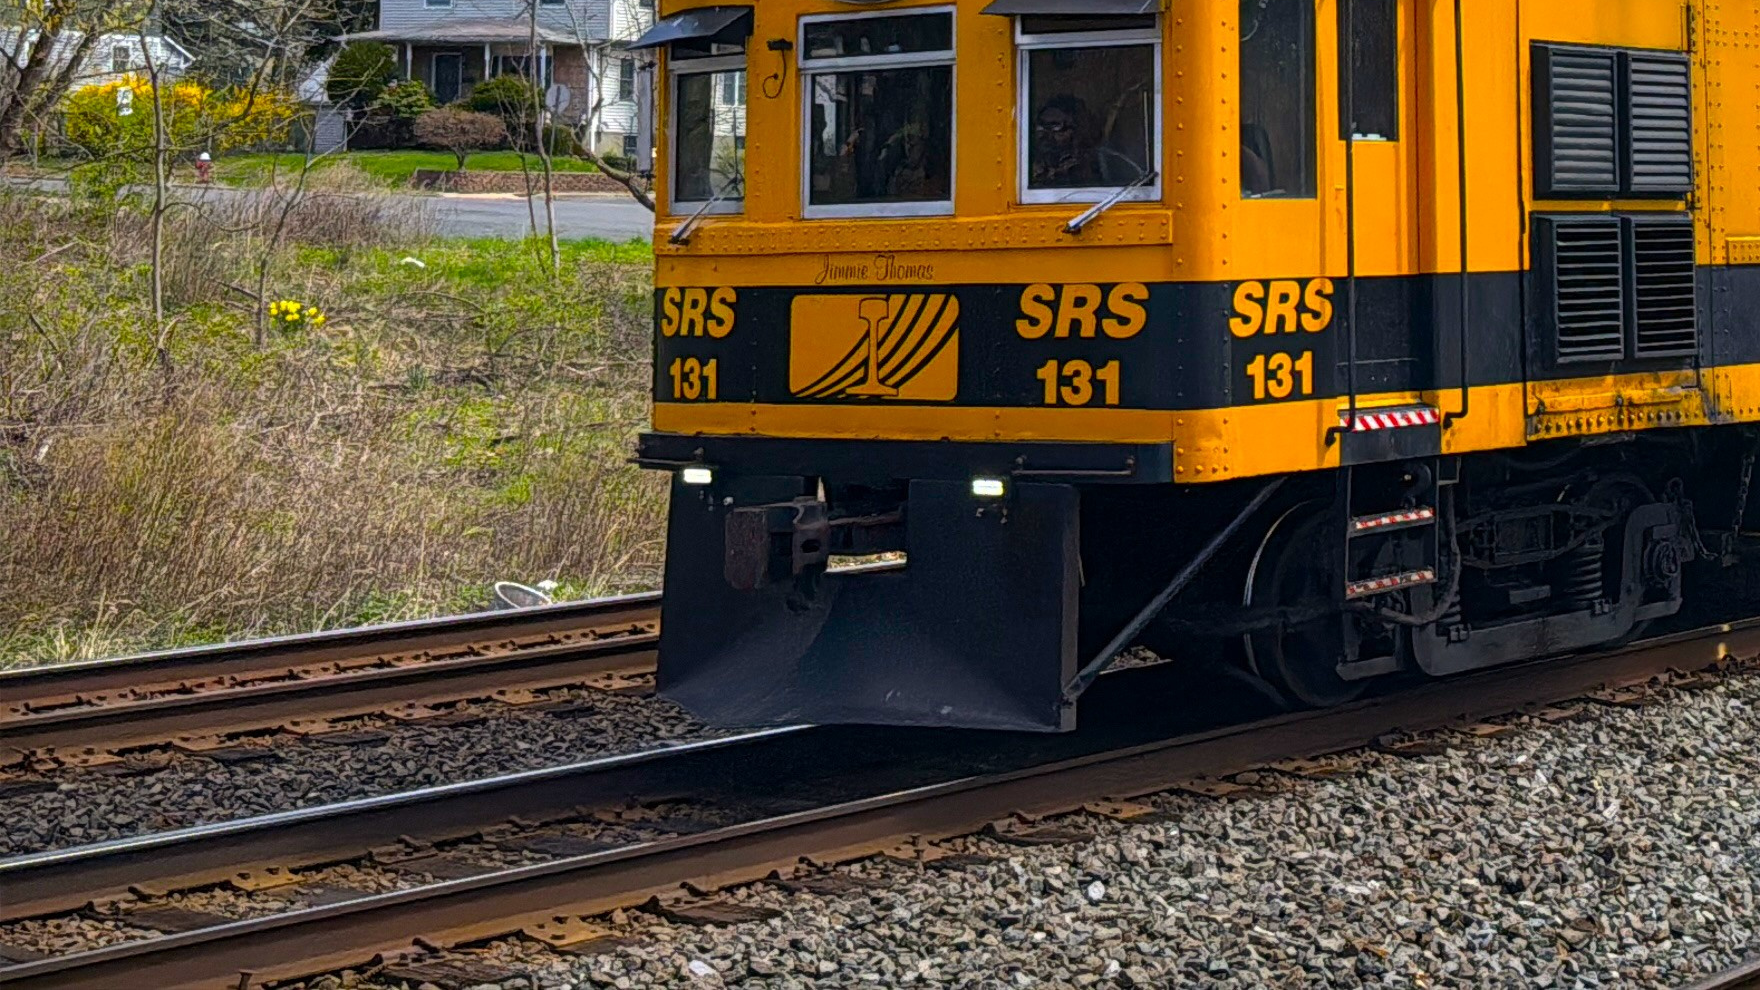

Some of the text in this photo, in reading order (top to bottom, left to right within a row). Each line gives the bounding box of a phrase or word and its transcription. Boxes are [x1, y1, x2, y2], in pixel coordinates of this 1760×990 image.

[814, 253, 935, 285] Jimmie Thomas
[661, 286, 737, 339] SRS
[1015, 282, 1149, 340] SRS
[1229, 277, 1335, 338] SRS
[669, 357, 718, 400] 131
[1036, 359, 1120, 406] 131
[1246, 350, 1313, 400] 131
